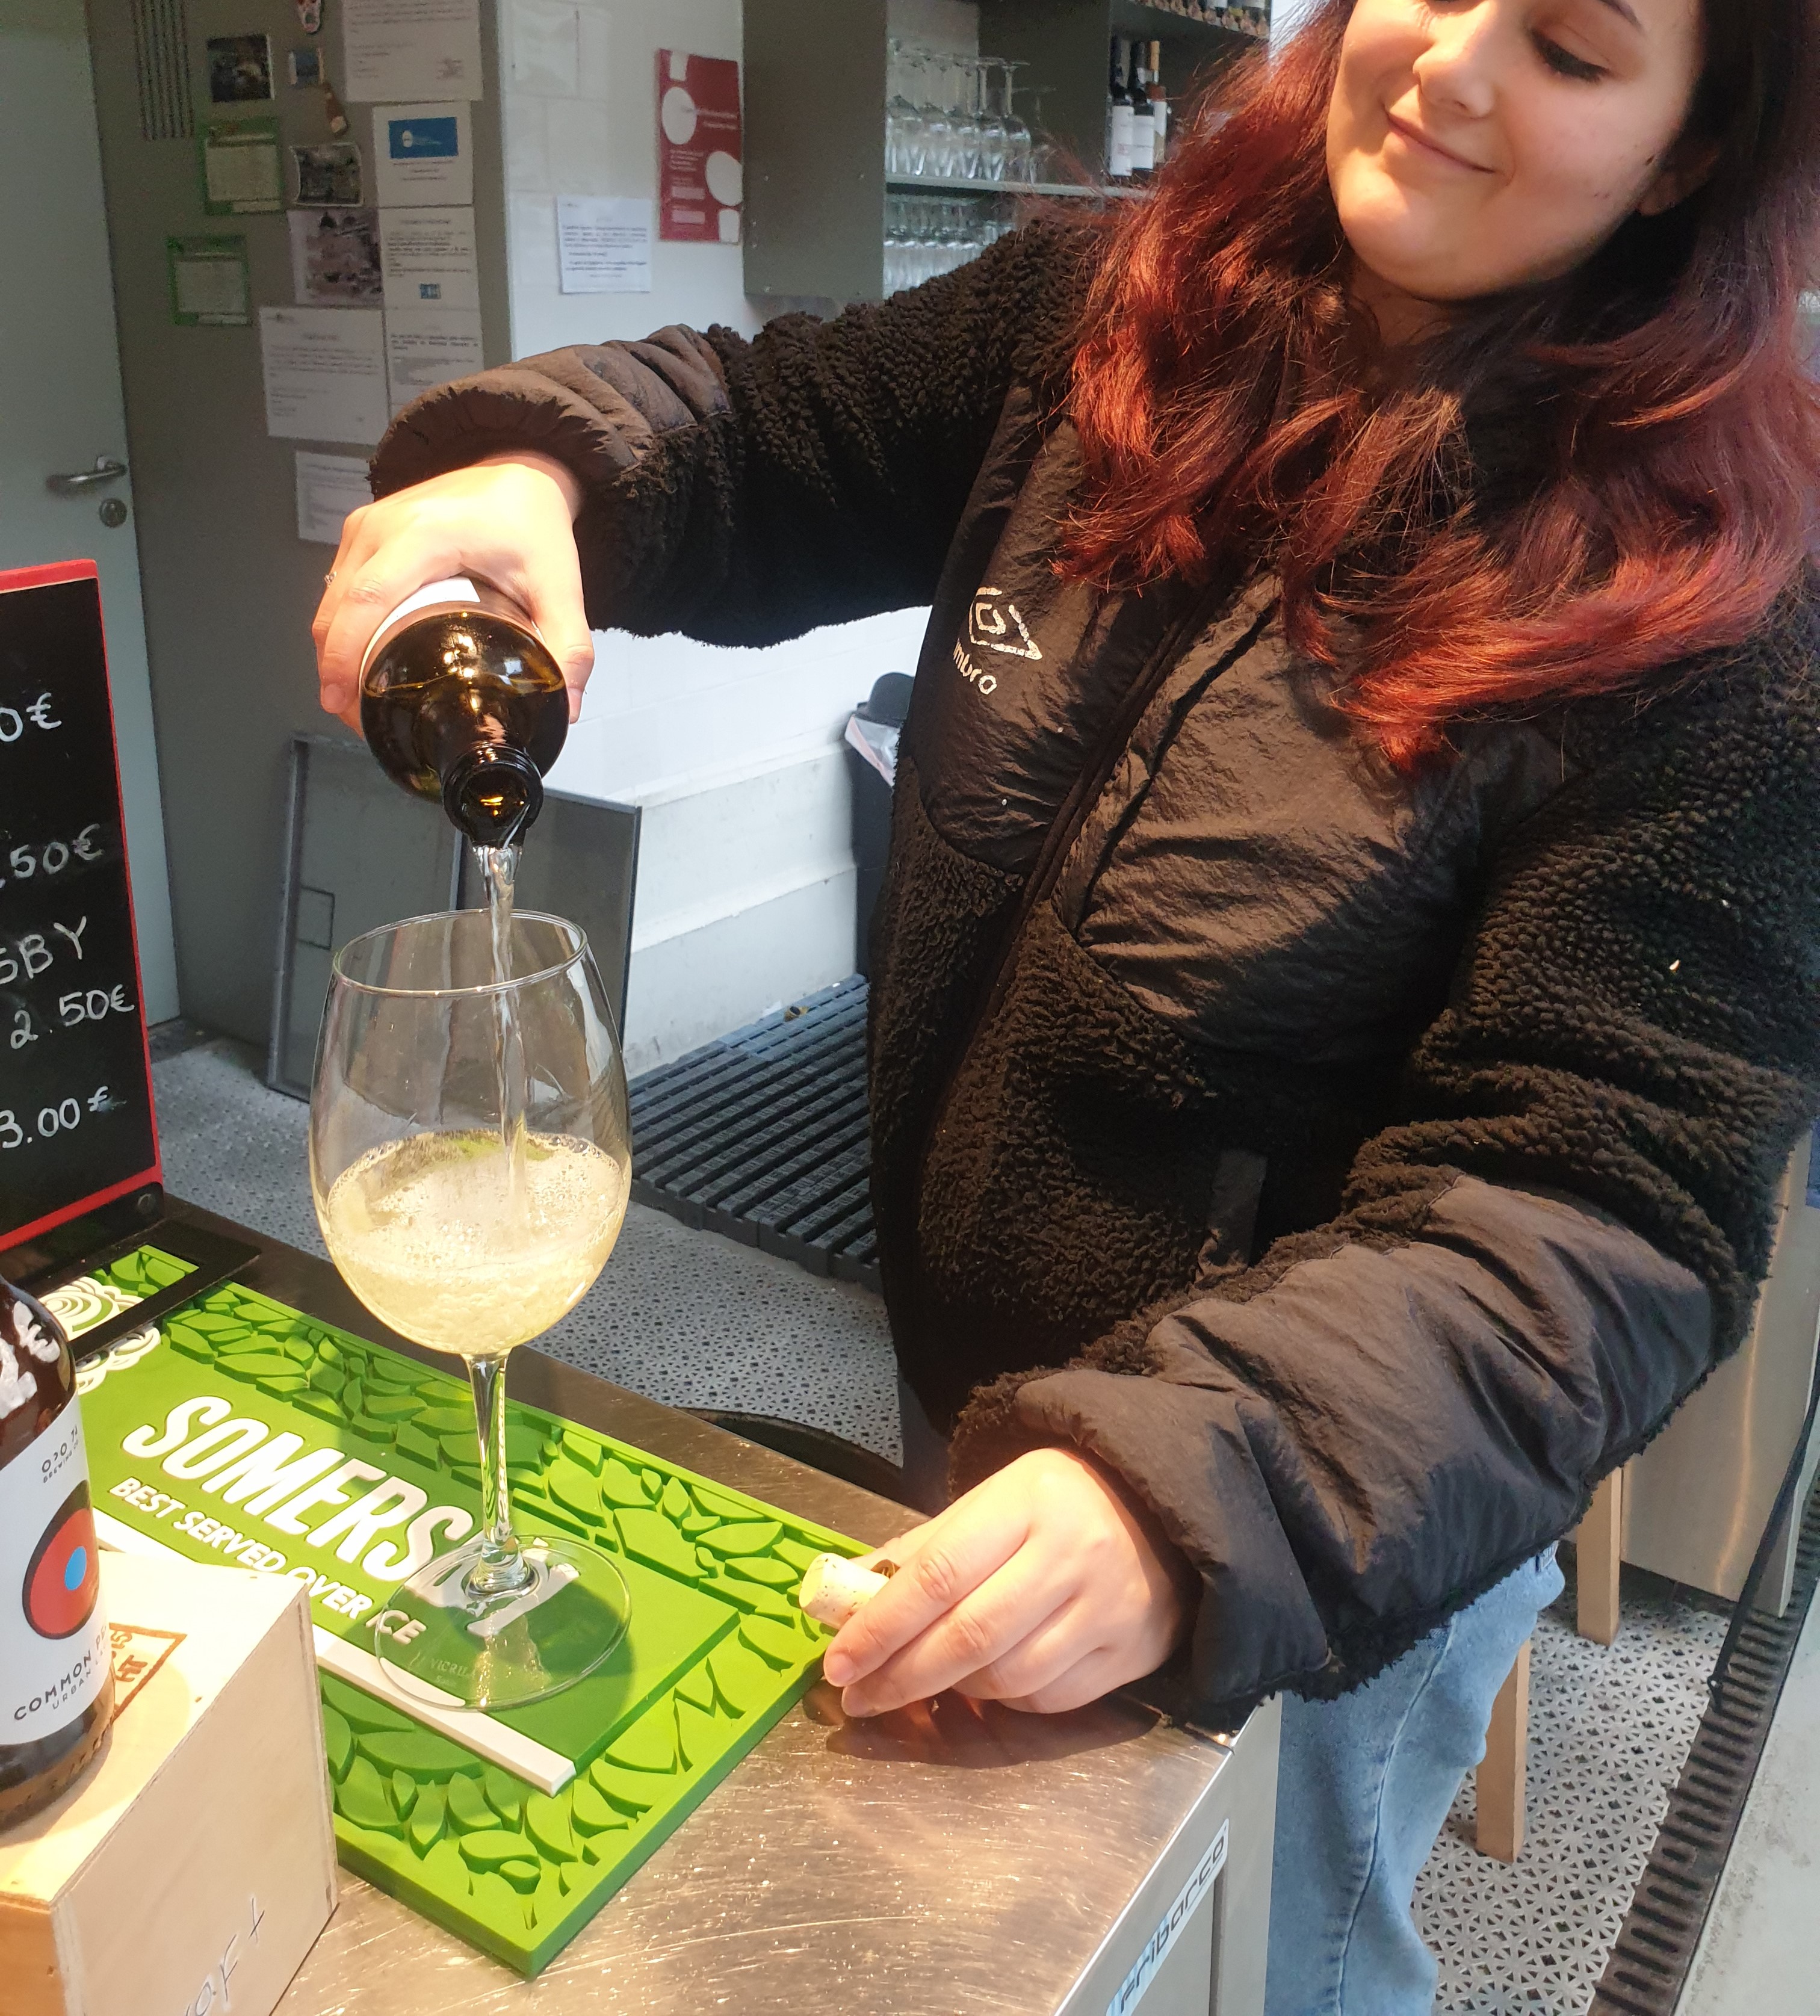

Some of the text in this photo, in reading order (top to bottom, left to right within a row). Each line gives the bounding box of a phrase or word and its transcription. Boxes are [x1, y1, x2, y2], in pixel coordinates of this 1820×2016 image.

[10, 984, 135, 1050] 2.50€
[109, 1477, 187, 1519] BEST
[173, 1510, 288, 1572] SERVED
[366, 1610, 427, 1644] ICE
[14, 1650, 91, 1721] COMMON
[52, 1669, 91, 1710] URBAN
